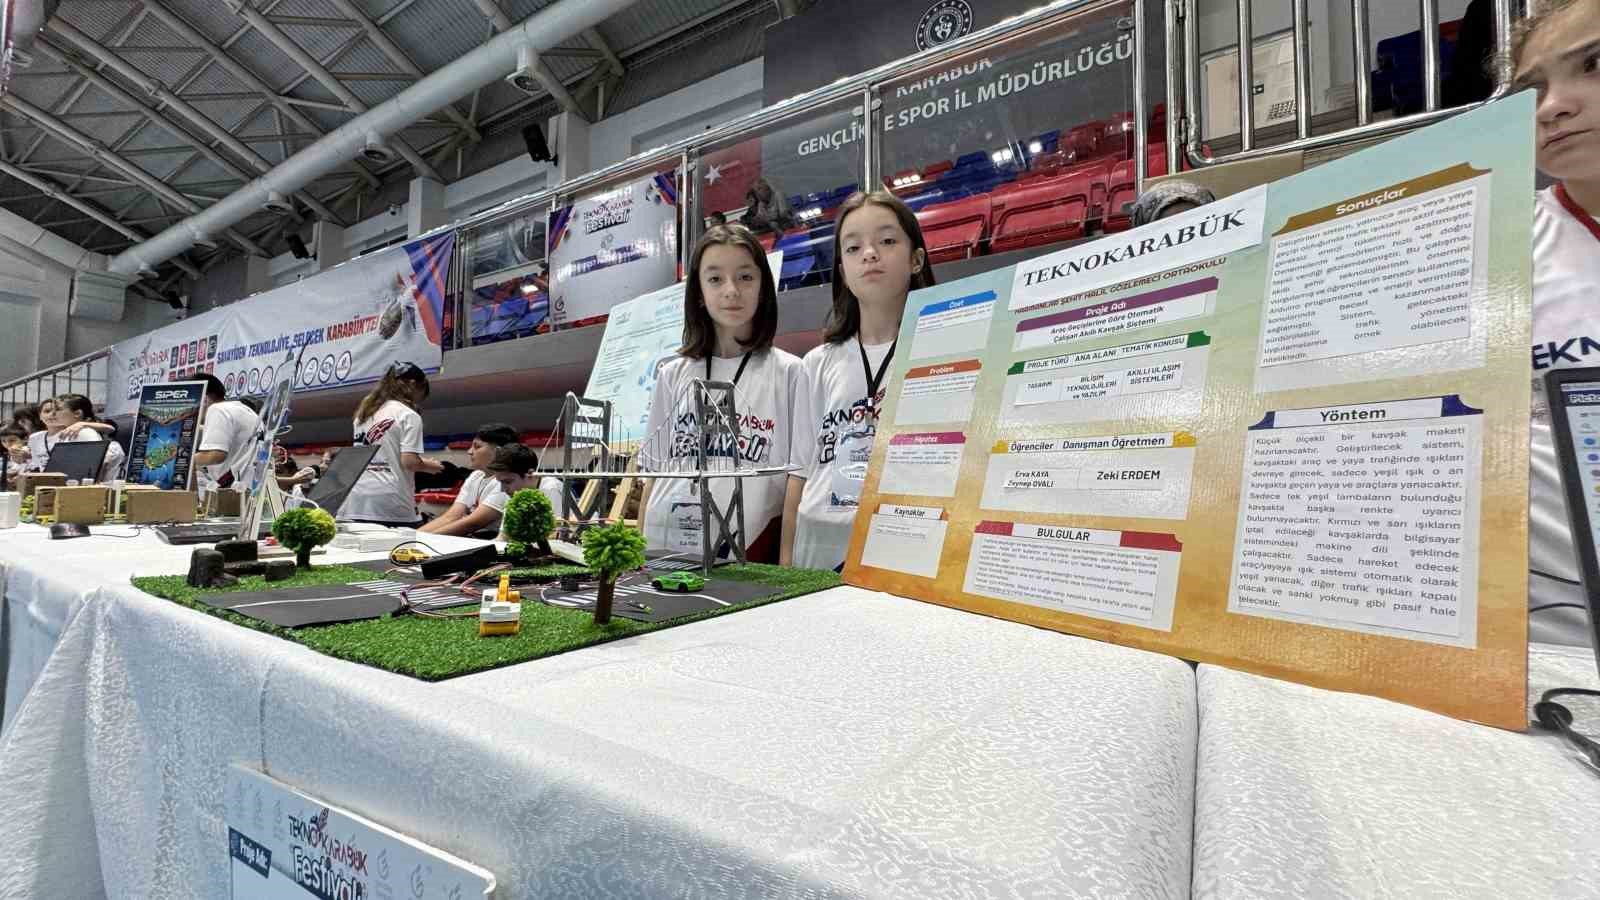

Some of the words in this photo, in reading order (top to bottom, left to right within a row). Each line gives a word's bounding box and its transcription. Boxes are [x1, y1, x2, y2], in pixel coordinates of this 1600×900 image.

[898, 98, 950, 127] SPOR
[953, 88, 974, 113] İL
[977, 35, 1133, 103] MÜDÜRLÜĞÜ
[1335, 187, 1408, 216] Sonuçlar
[1024, 208, 1246, 287] TEKNOKARABÜK
[1127, 305, 1165, 319] Otomatik
[1126, 317, 1157, 329] Sistemi
[1153, 336, 1185, 348] KONUSU
[1075, 353, 1092, 361] ANA
[1027, 360, 1049, 369] PROJE
[1320, 408, 1386, 422] Yöntem
[1342, 433, 1353, 441] bir
[1426, 427, 1465, 436] maketi
[1010, 441, 1054, 453] Öğrenciler
[1062, 438, 1109, 450] Danışman
[1111, 434, 1166, 450] Öğretmen
[1030, 470, 1049, 478] KAYA
[1096, 470, 1120, 481] Zeki
[1120, 470, 1161, 480] ERDEM
[1400, 494, 1462, 504] bulunduğu
[1360, 506, 1393, 514] renkte
[1037, 527, 1090, 542] BULGULAR
[1404, 534, 1460, 544] bilgisayar
[1410, 548, 1459, 558] şeklinde
[1358, 557, 1399, 568] hareket
[1415, 562, 1459, 573] edecek
[1363, 572, 1412, 583] otomatik
[1420, 576, 1458, 588] olarak
[1393, 601, 1422, 613] pasif
[1430, 606, 1456, 617] hale
